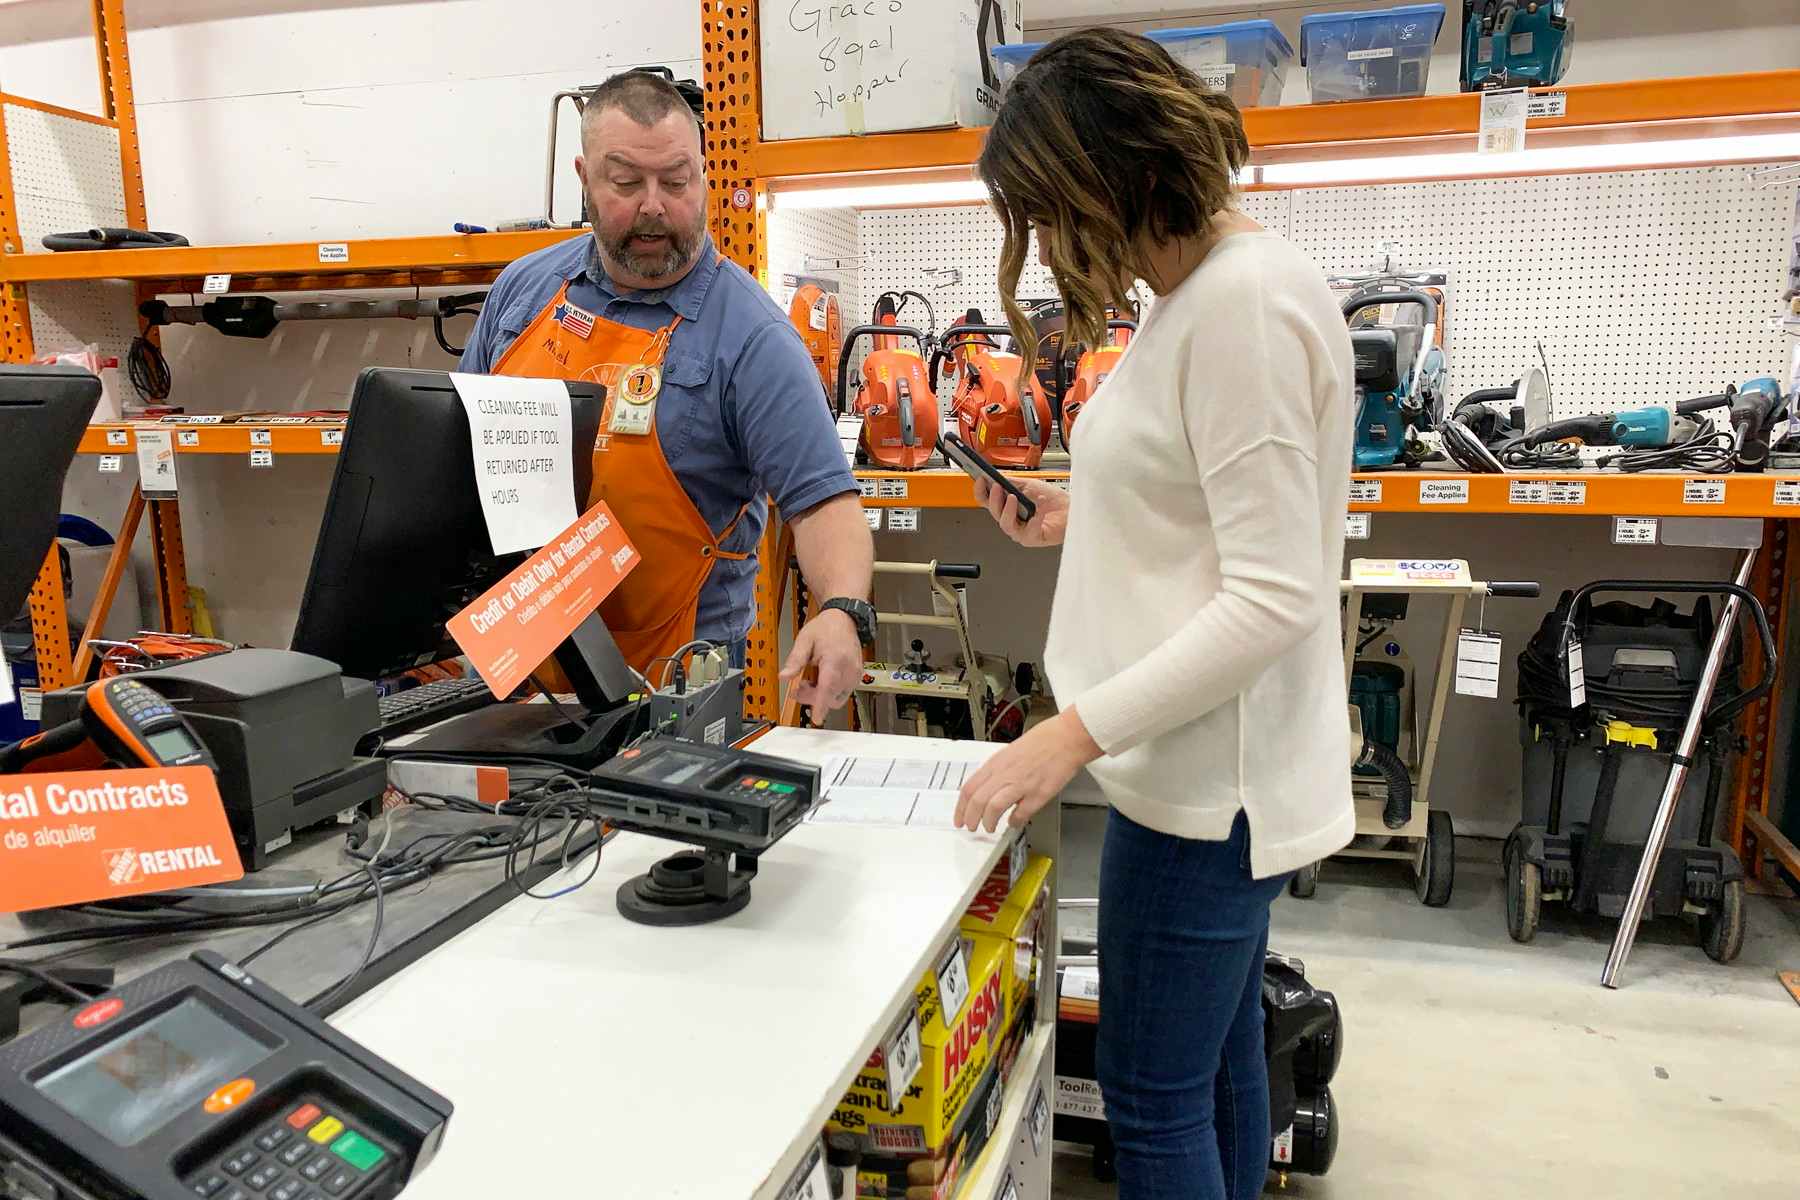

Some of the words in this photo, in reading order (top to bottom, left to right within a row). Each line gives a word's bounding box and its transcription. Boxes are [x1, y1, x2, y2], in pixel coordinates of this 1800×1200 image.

[789, 0, 902, 38] Graco
[976, 87, 1001, 113] GRAC
[478, 400, 522, 416] CLEANING
[523, 401, 539, 416] FEE
[540, 402, 559, 417] WILL
[483, 429, 494, 445] BE
[496, 429, 529, 445] APPLIED
[531, 430, 538, 445] IF
[539, 430, 560, 444] TOOL
[486, 459, 529, 475] RETURNED
[530, 458, 554, 473] AFTER
[491, 488, 520, 505] HOURS
[1421, 491, 1436, 499] Fee
[1438, 491, 1467, 500] Applies
[1427, 484, 1461, 492] Cleaning
[470, 597, 507, 634] Credit
[502, 590, 517, 611] or
[510, 572, 541, 602] Debit
[533, 560, 560, 584] Only
[550, 551, 567, 569] for
[560, 531, 587, 559] Rental
[579, 511, 611, 544] Contracts
[0, 785, 39, 820] tal
[45, 778, 190, 816] Contracts
[4, 828, 29, 850] de
[34, 823, 97, 849] alquiler
[139, 845, 223, 875] RENTAL
[943, 968, 1002, 1093] HUSKY
[1059, 1079, 1102, 1096] ToolRe
[830, 1110, 866, 1128] ags
